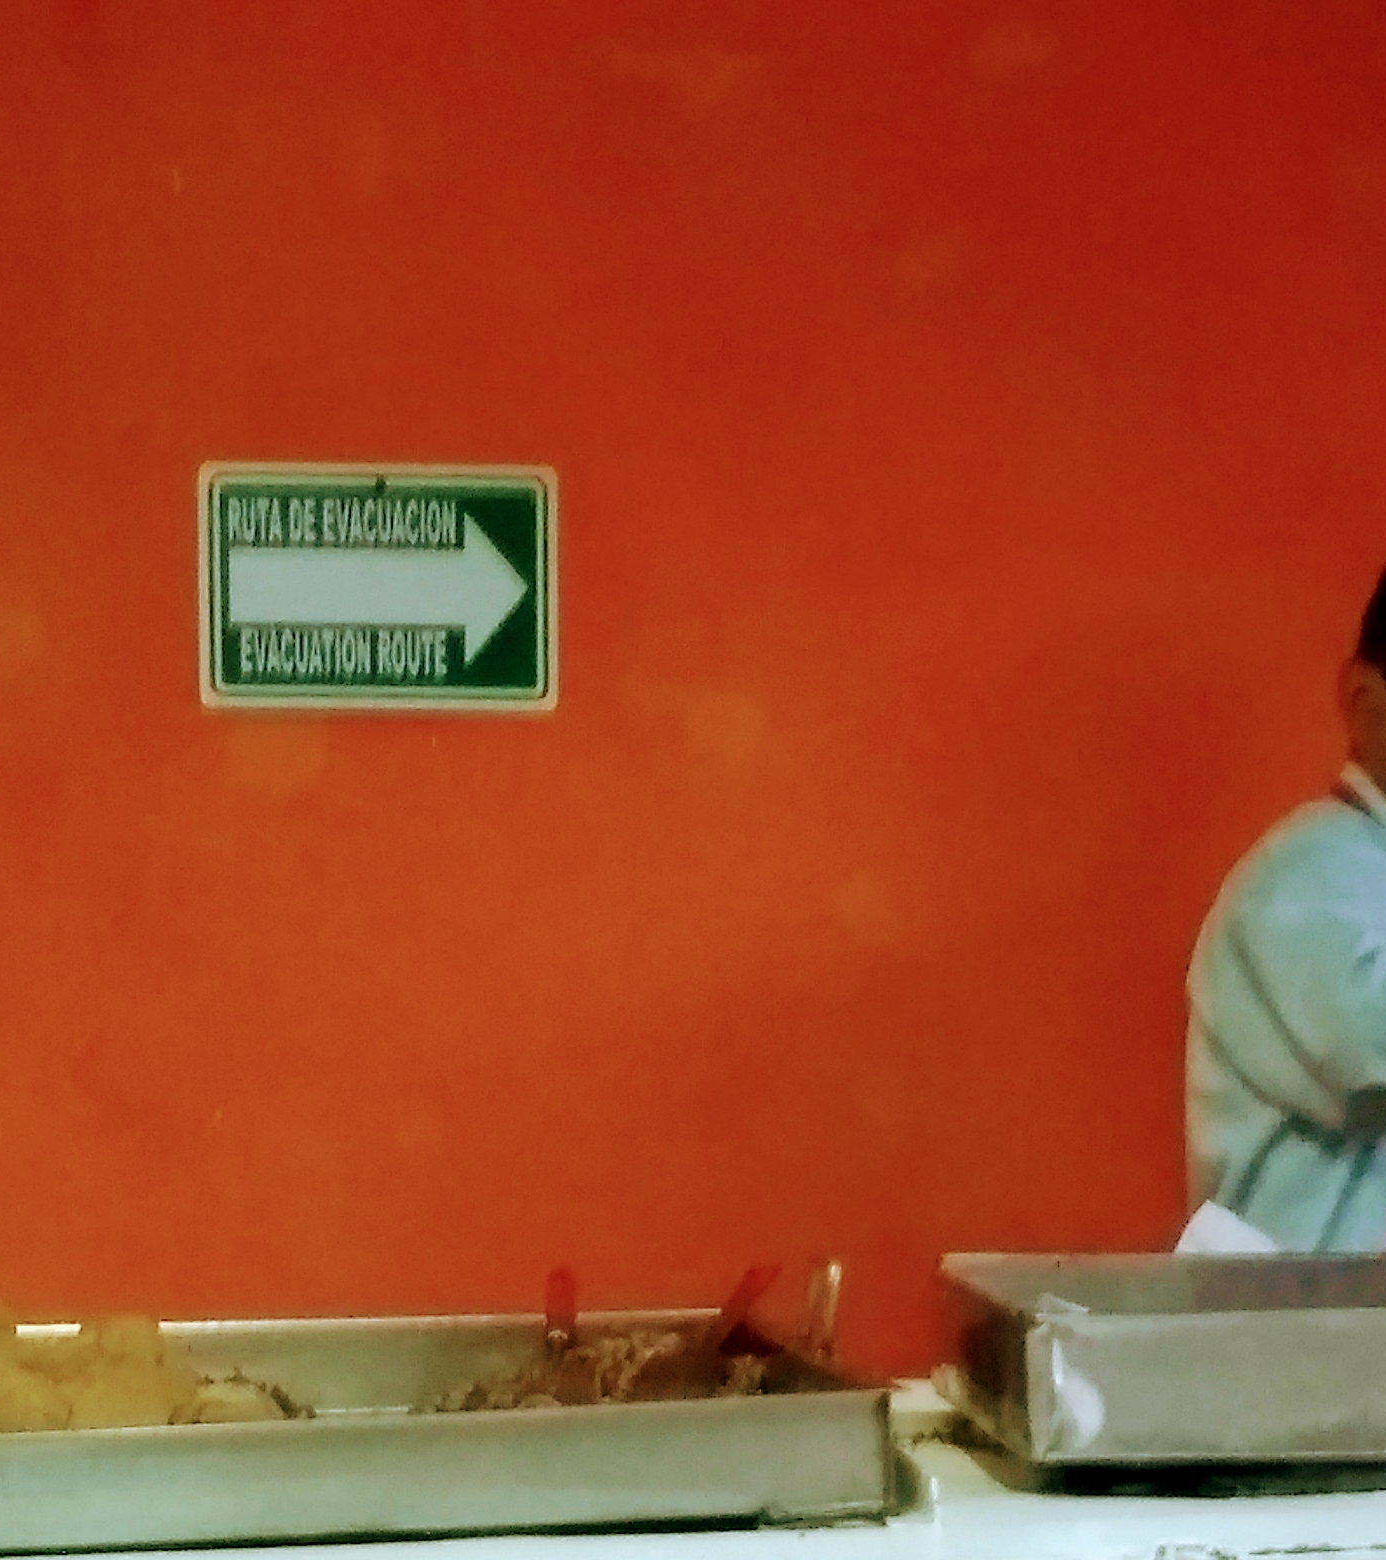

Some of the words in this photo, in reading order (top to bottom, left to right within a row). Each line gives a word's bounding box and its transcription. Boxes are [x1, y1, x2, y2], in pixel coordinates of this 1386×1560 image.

[228, 497, 282, 543] RUTA
[289, 498, 316, 543] DE
[323, 497, 457, 545] EVACUACION
[240, 627, 372, 675] EVACUATION
[377, 629, 448, 677] ROUTE
